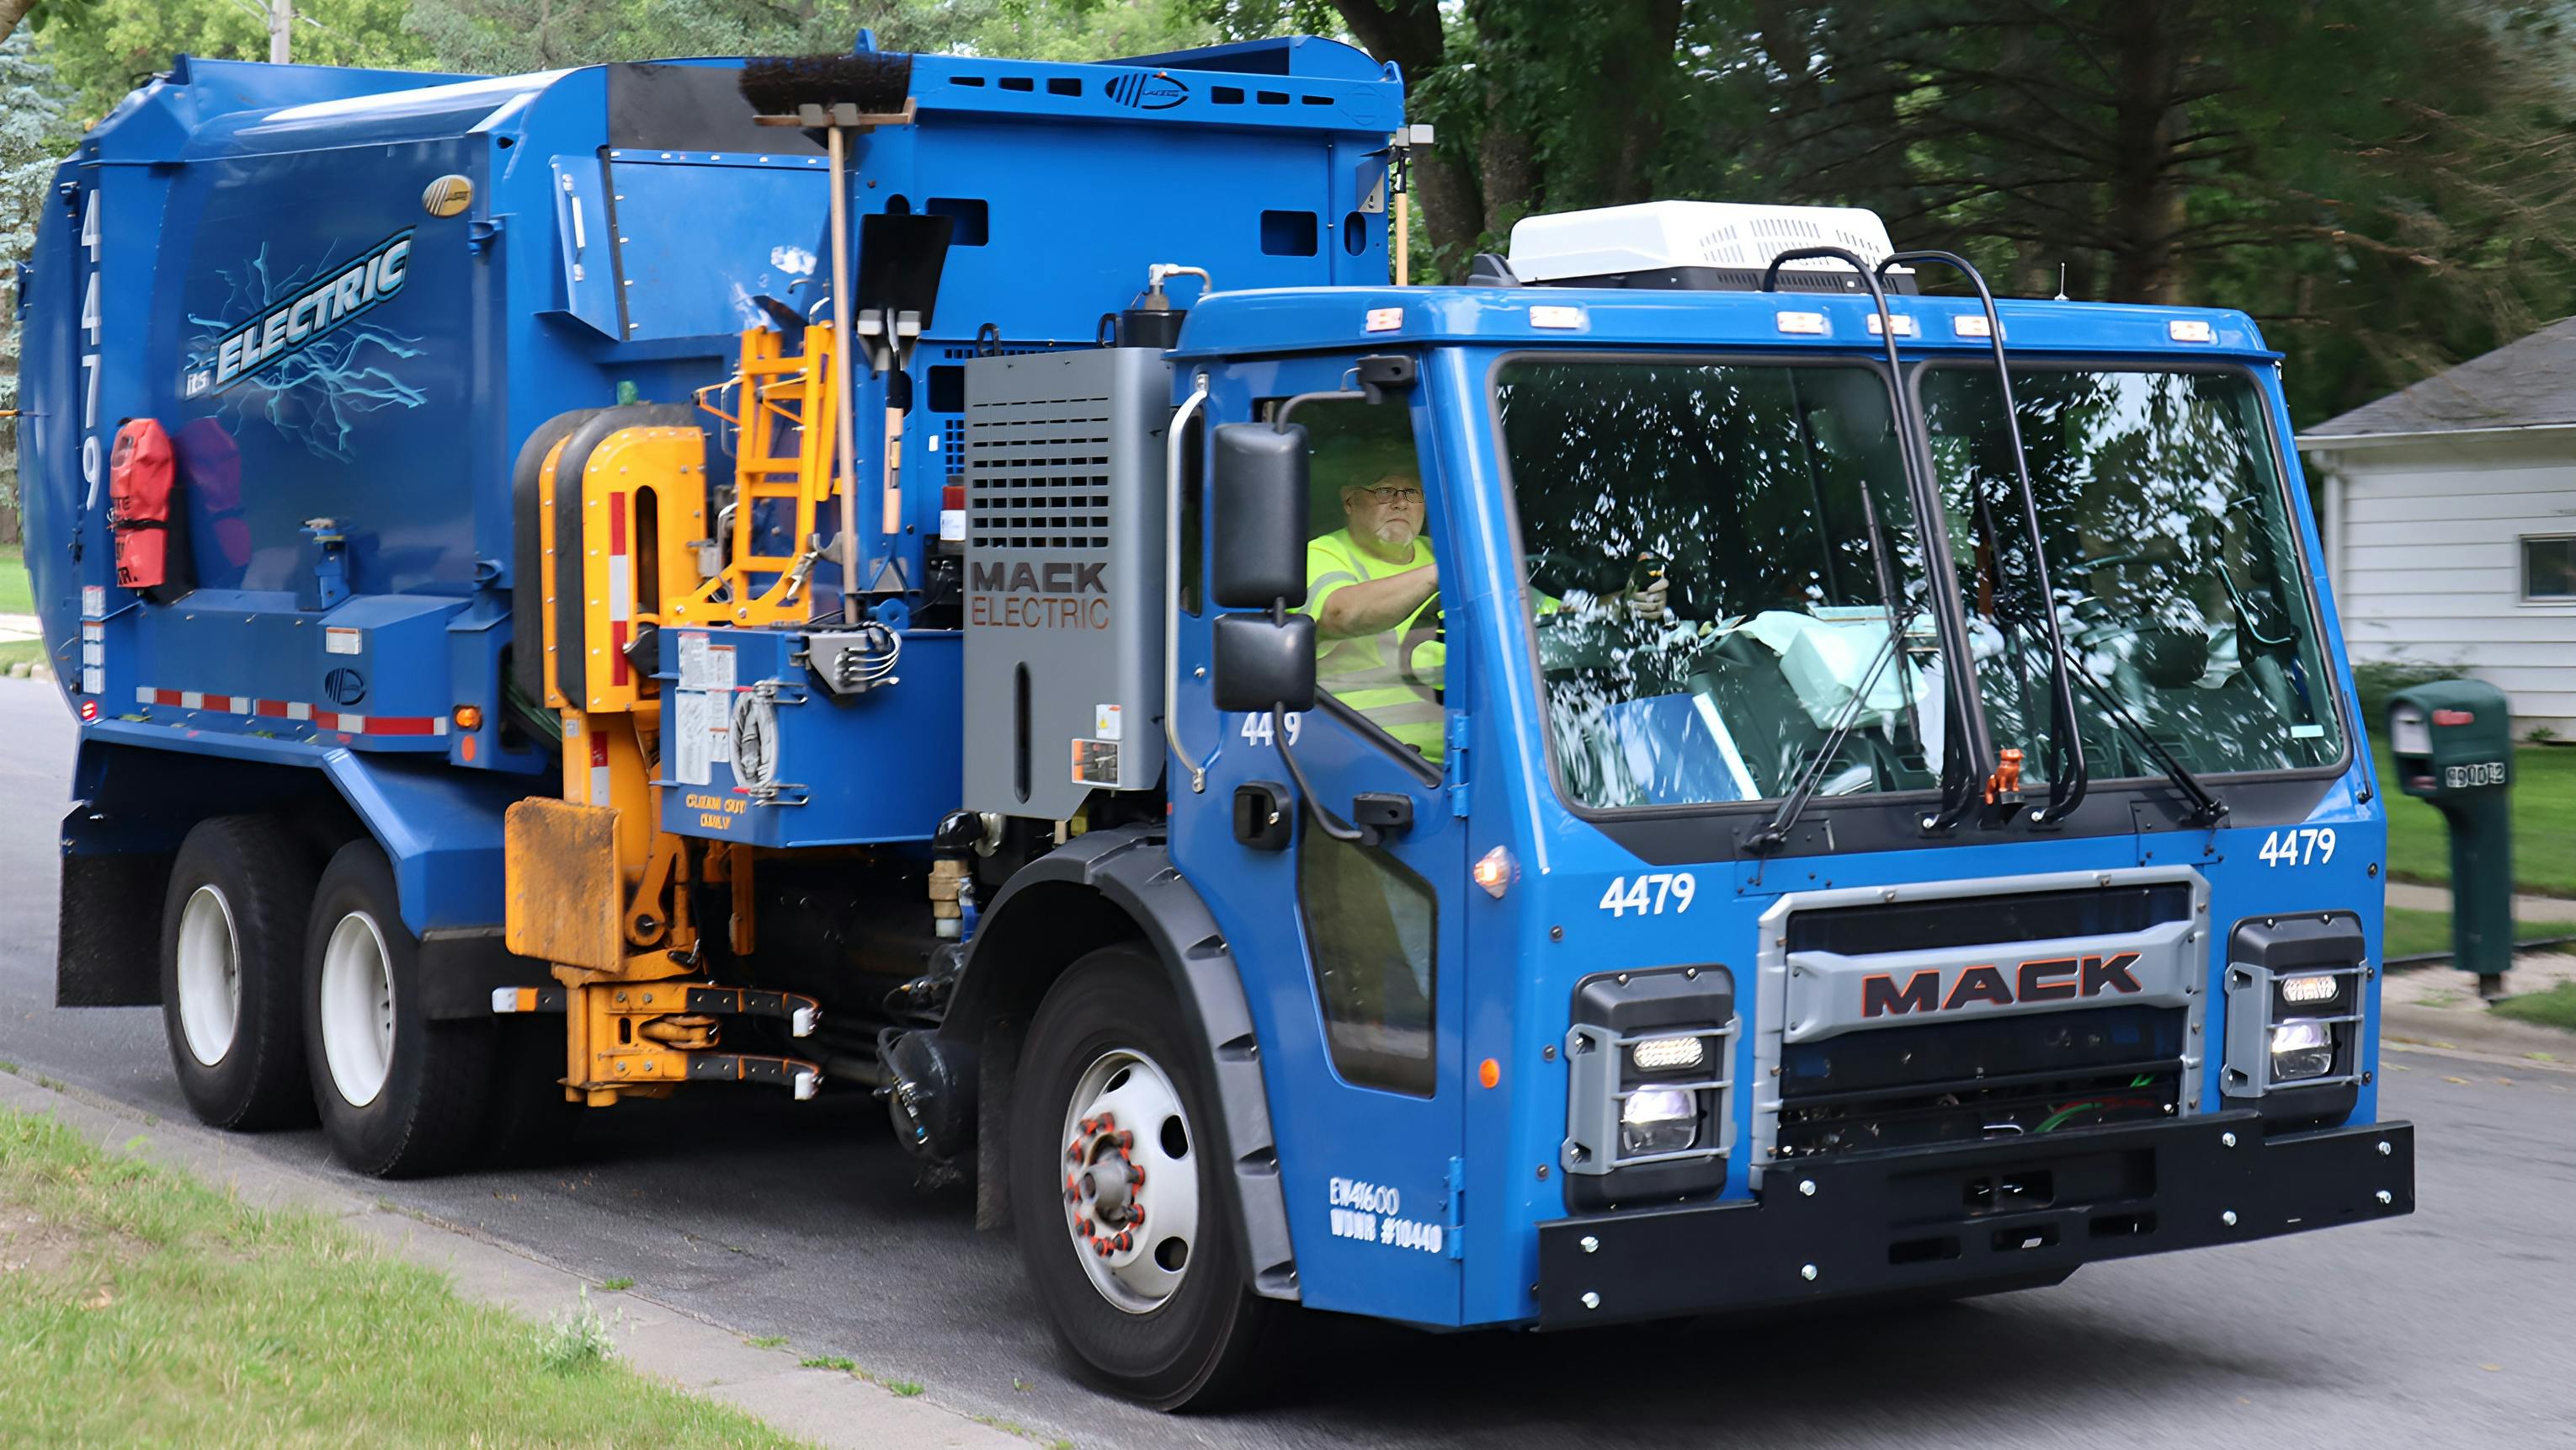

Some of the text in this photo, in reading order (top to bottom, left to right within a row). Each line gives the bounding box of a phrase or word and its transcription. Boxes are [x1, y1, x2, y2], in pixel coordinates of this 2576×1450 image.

[215, 239, 412, 386] ELECTRIC
[82, 189, 102, 511] 4479
[971, 562, 1108, 594] MACK
[972, 596, 1110, 630] ELECTRIC
[1241, 712, 1301, 747] 449
[2259, 828, 2336, 867] 4479
[1599, 872, 1695, 917] 4479
[1862, 952, 2142, 1017] MACK
